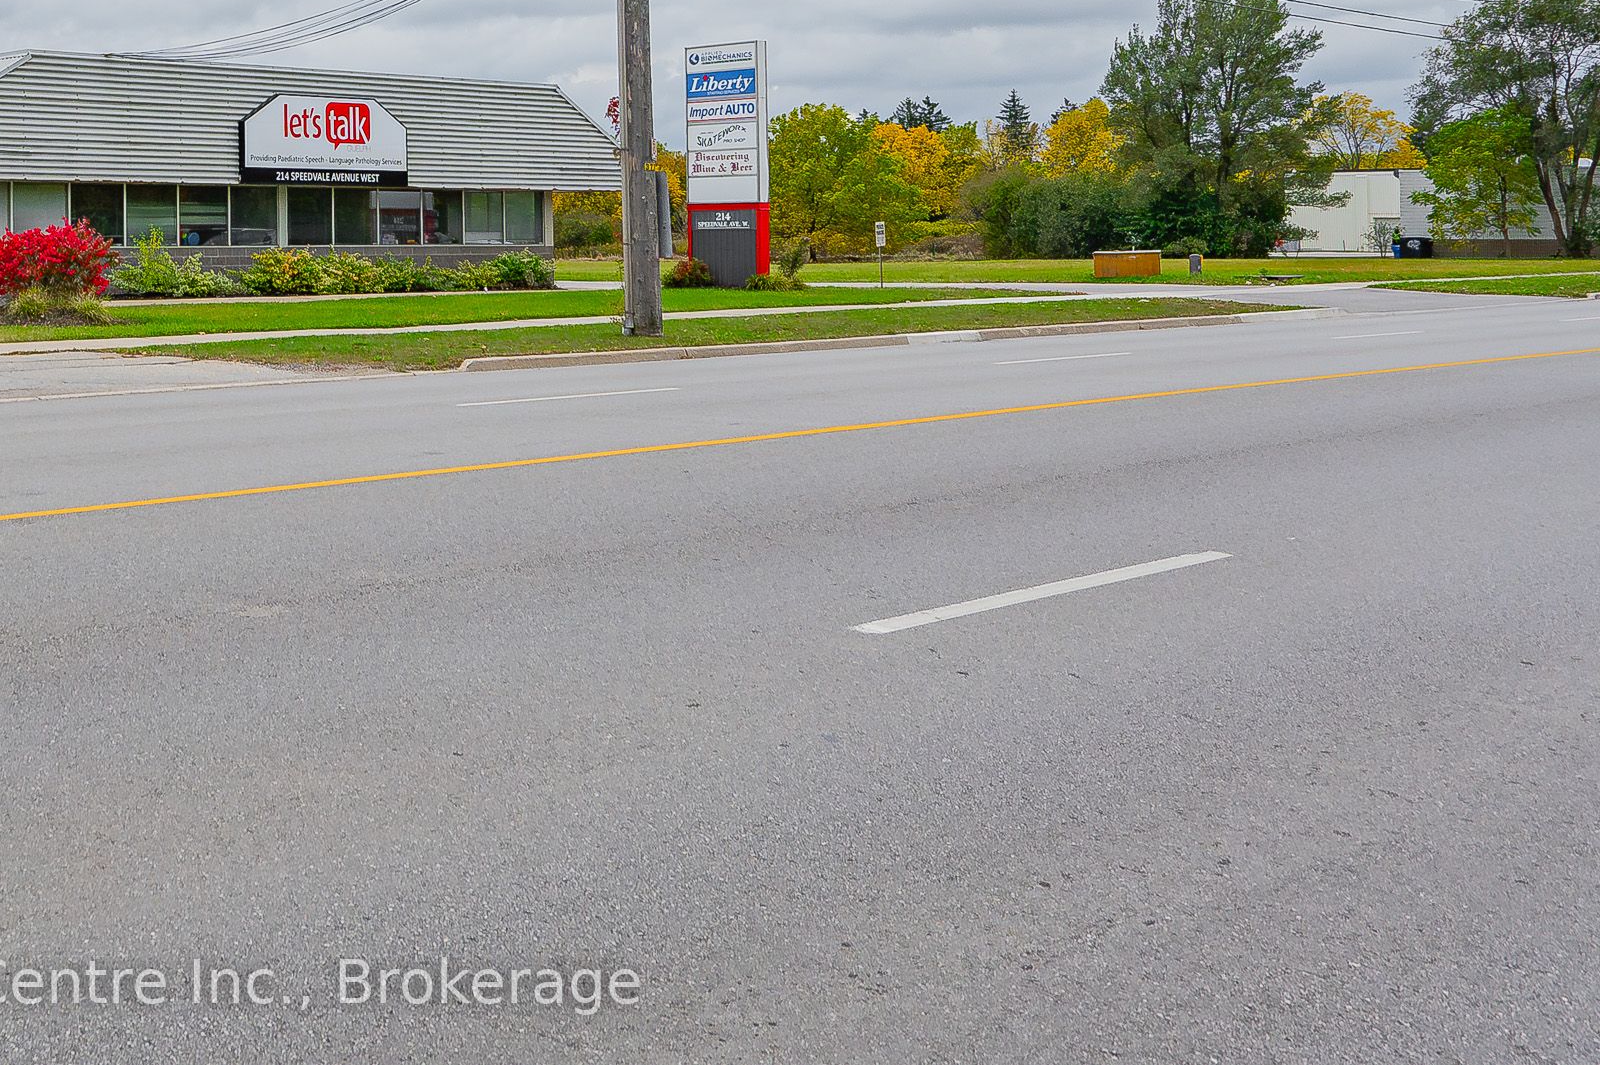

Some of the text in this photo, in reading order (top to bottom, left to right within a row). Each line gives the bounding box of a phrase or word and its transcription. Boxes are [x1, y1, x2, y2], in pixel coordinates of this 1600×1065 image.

[700, 51, 753, 62] BIOMECHANICS
[689, 74, 754, 93] Liberty
[689, 102, 755, 119] Import AUTO
[284, 103, 369, 145] let's talk
[250, 154, 277, 164] Providing
[277, 155, 304, 163] Paediatric
[305, 155, 325, 165] Speech
[328, 157, 355, 166] Language
[355, 157, 381, 167] Pathology
[381, 158, 402, 166] Services
[694, 152, 749, 163] Discovering
[691, 161, 753, 176] Wine & Beer
[276, 171, 380, 183] 214 SPEEDVALE AVENUE WEST
[715, 211, 731, 221] 214
